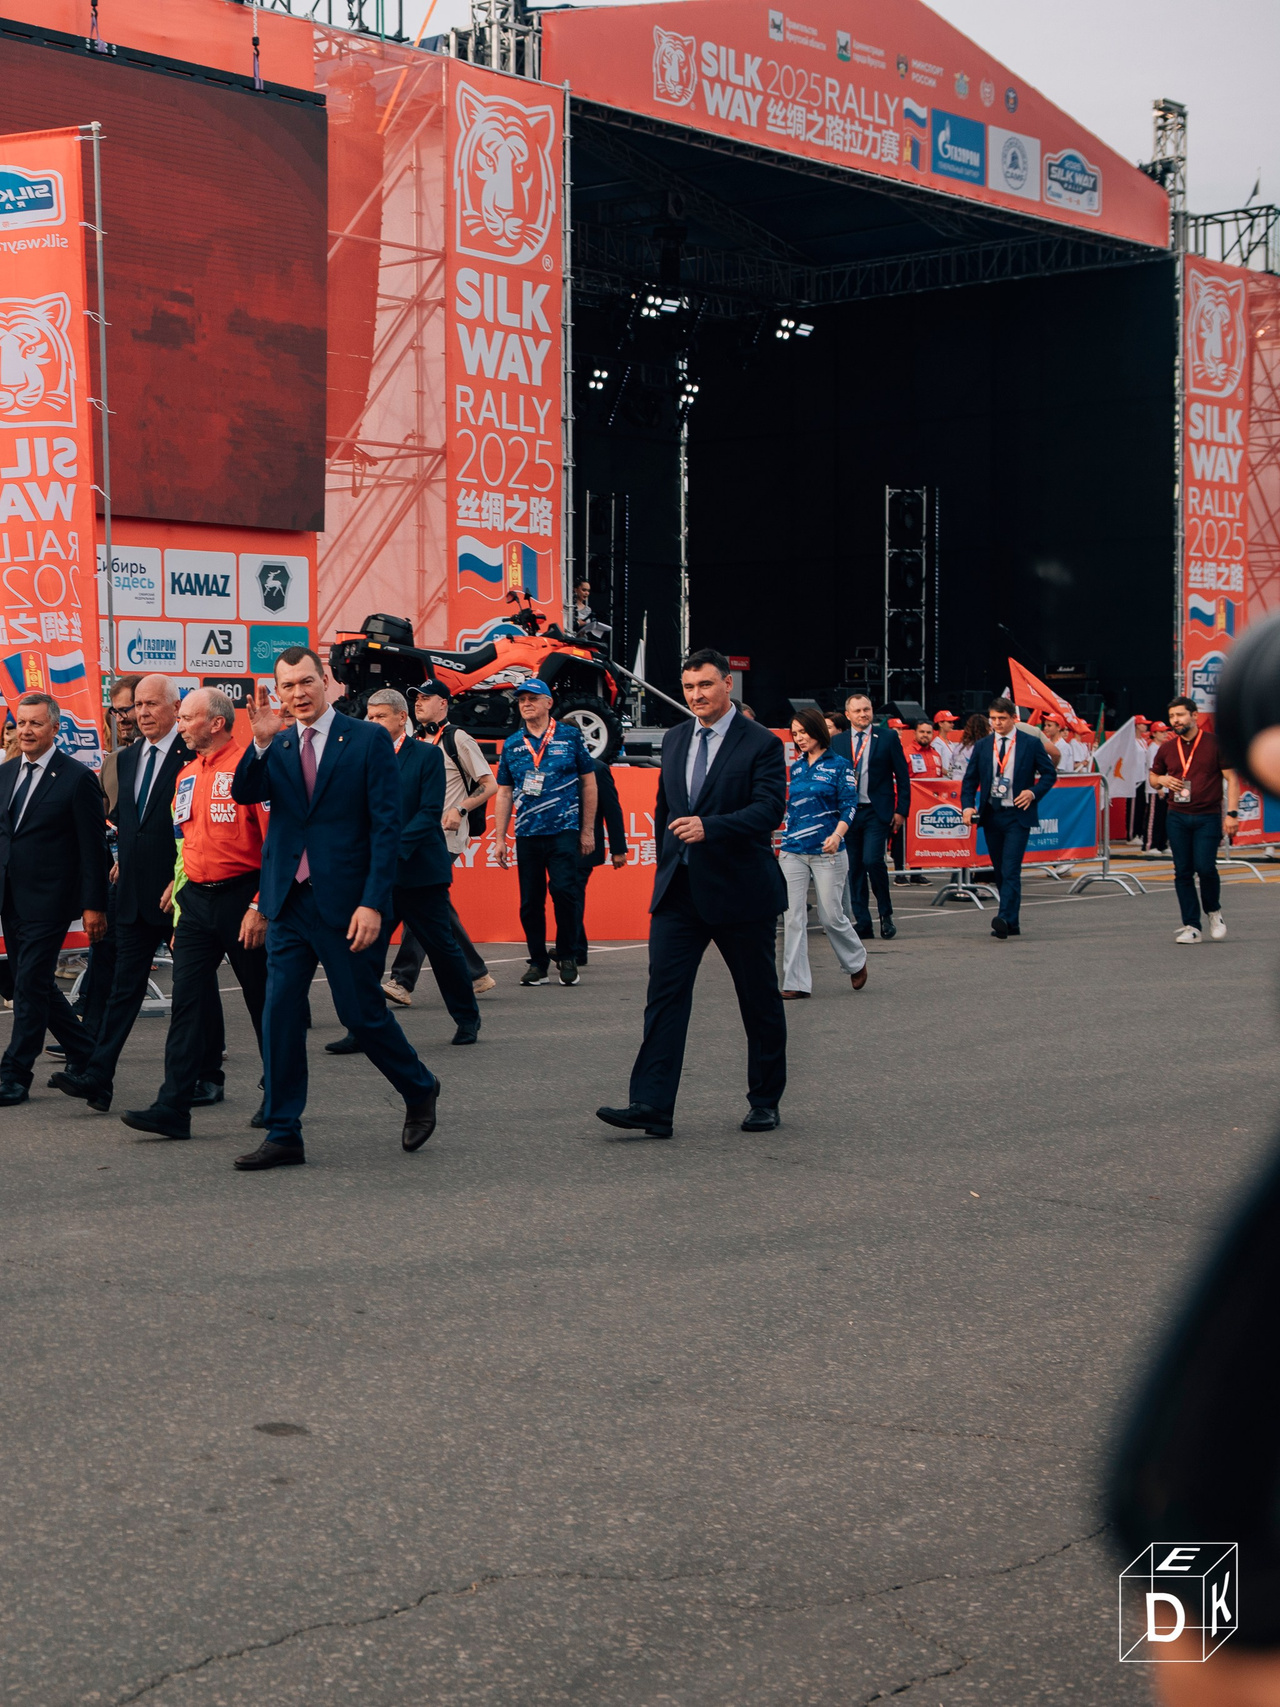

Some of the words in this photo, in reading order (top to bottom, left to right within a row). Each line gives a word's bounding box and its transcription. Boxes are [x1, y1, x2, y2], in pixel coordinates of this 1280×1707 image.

[700, 41, 764, 91] SILK
[700, 78, 763, 128] WAY
[766, 60, 822, 106] 2025
[824, 76, 900, 128] RALLY
[1050, 165, 1074, 183] SILK
[1075, 171, 1096, 188] WAY
[455, 267, 552, 334] SILK
[456, 322, 552, 387] WAY
[455, 384, 552, 435] RALLY
[1188, 402, 1243, 445] SILK
[455, 428, 555, 492] 2025
[1189, 442, 1243, 485] WAY
[456, 487, 554, 538] 丝绸之路
[1188, 486, 1244, 520] RALLY
[1188, 517, 1245, 561] 2025
[114, 574, 155, 591] здесь
[170, 571, 231, 598] KAMAZ
[143, 638, 177, 652] ГАЗПРОМ
[189, 659, 244, 668] ЛЕНЗОЛОТО
[210, 803, 235, 813] SILK
[210, 812, 236, 823] WAY
[922, 816, 945, 824] SILK
[914, 849, 970, 859] #silkwayrally2025
